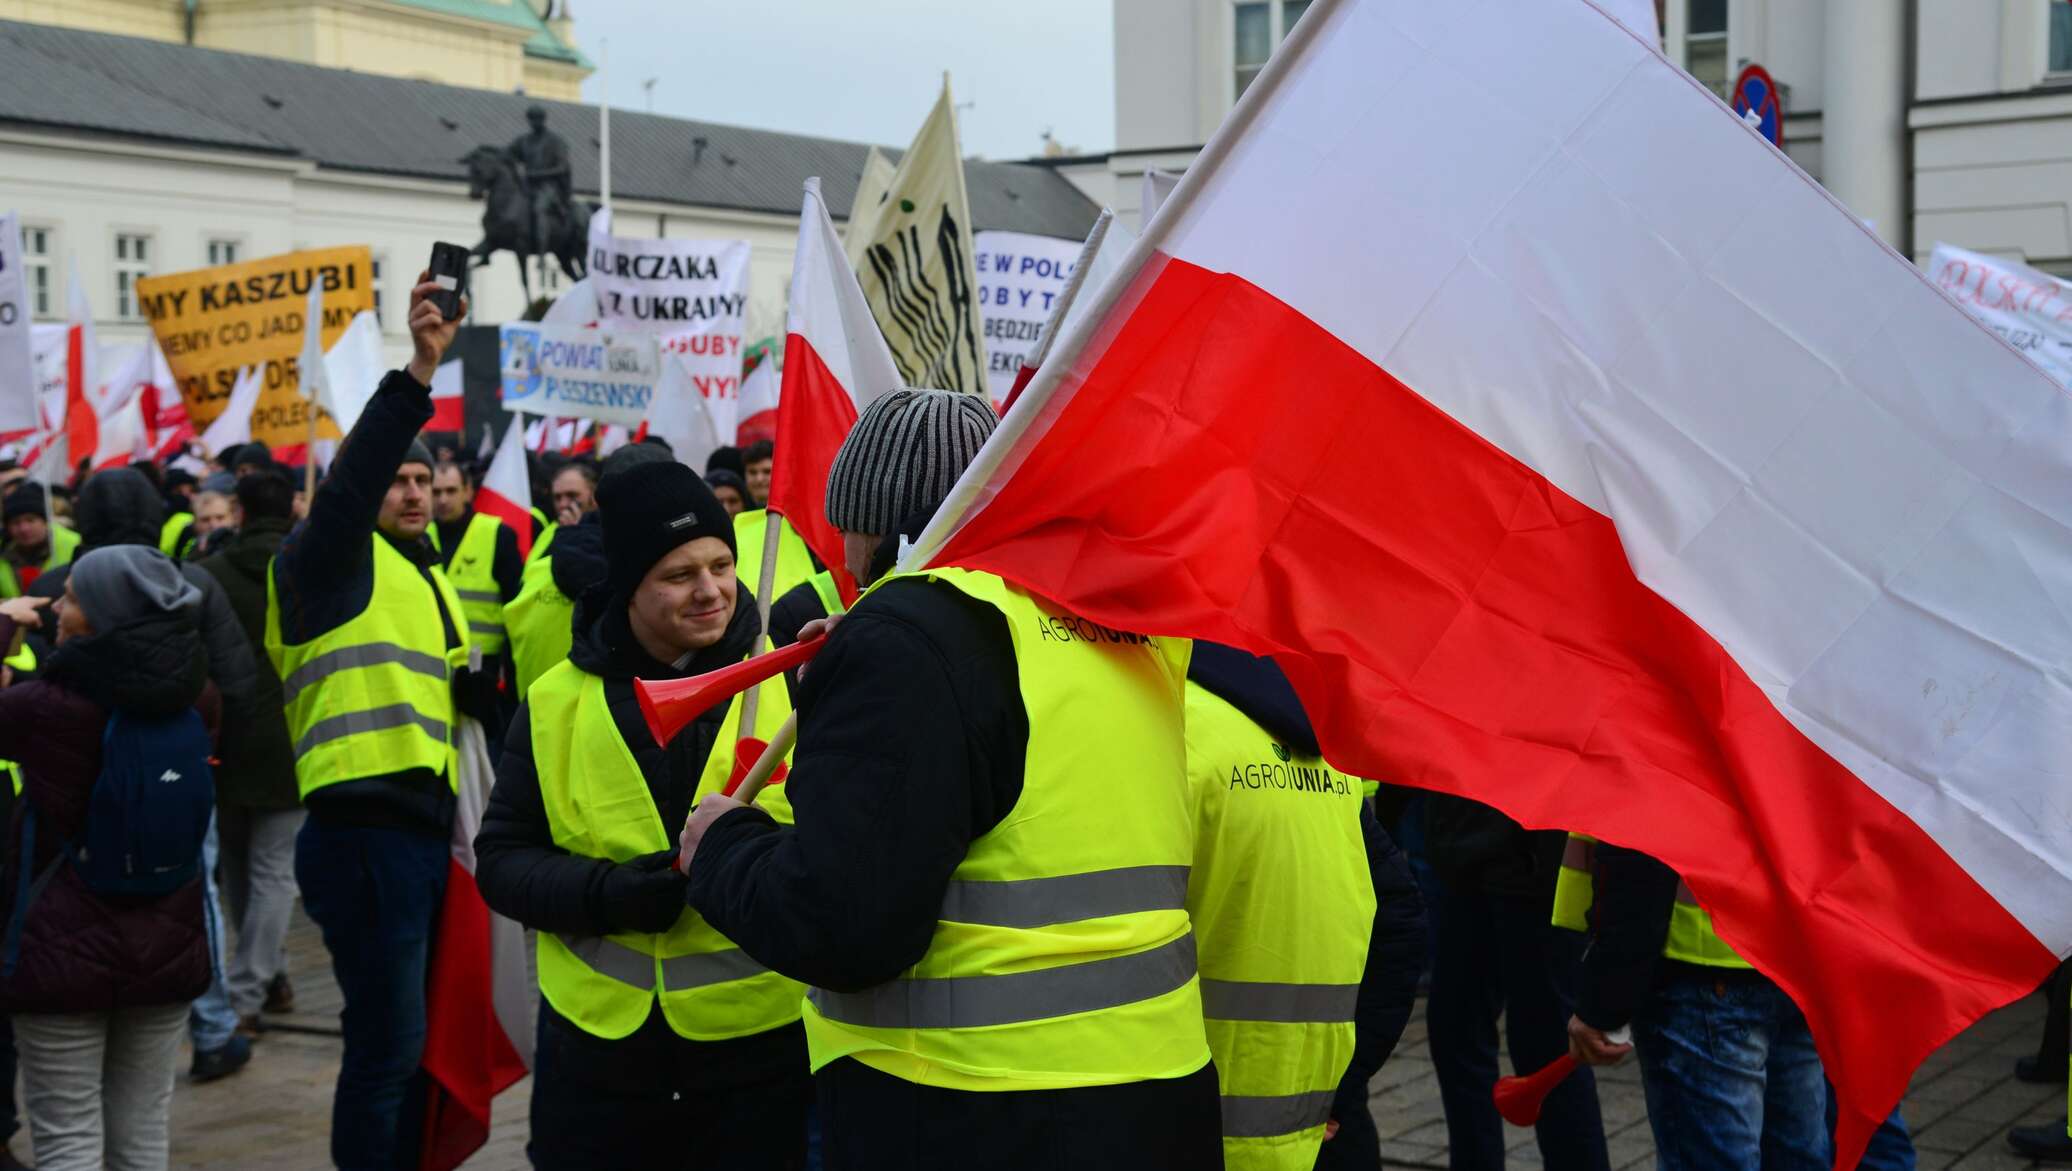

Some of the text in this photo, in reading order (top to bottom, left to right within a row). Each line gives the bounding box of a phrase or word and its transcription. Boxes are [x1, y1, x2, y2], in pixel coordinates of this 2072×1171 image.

[142, 263, 356, 322] MY KASZUBI
[632, 294, 747, 320] UKRAINY
[217, 320, 249, 345] CO
[257, 307, 363, 337] JADMY
[542, 340, 602, 370] POWIAT
